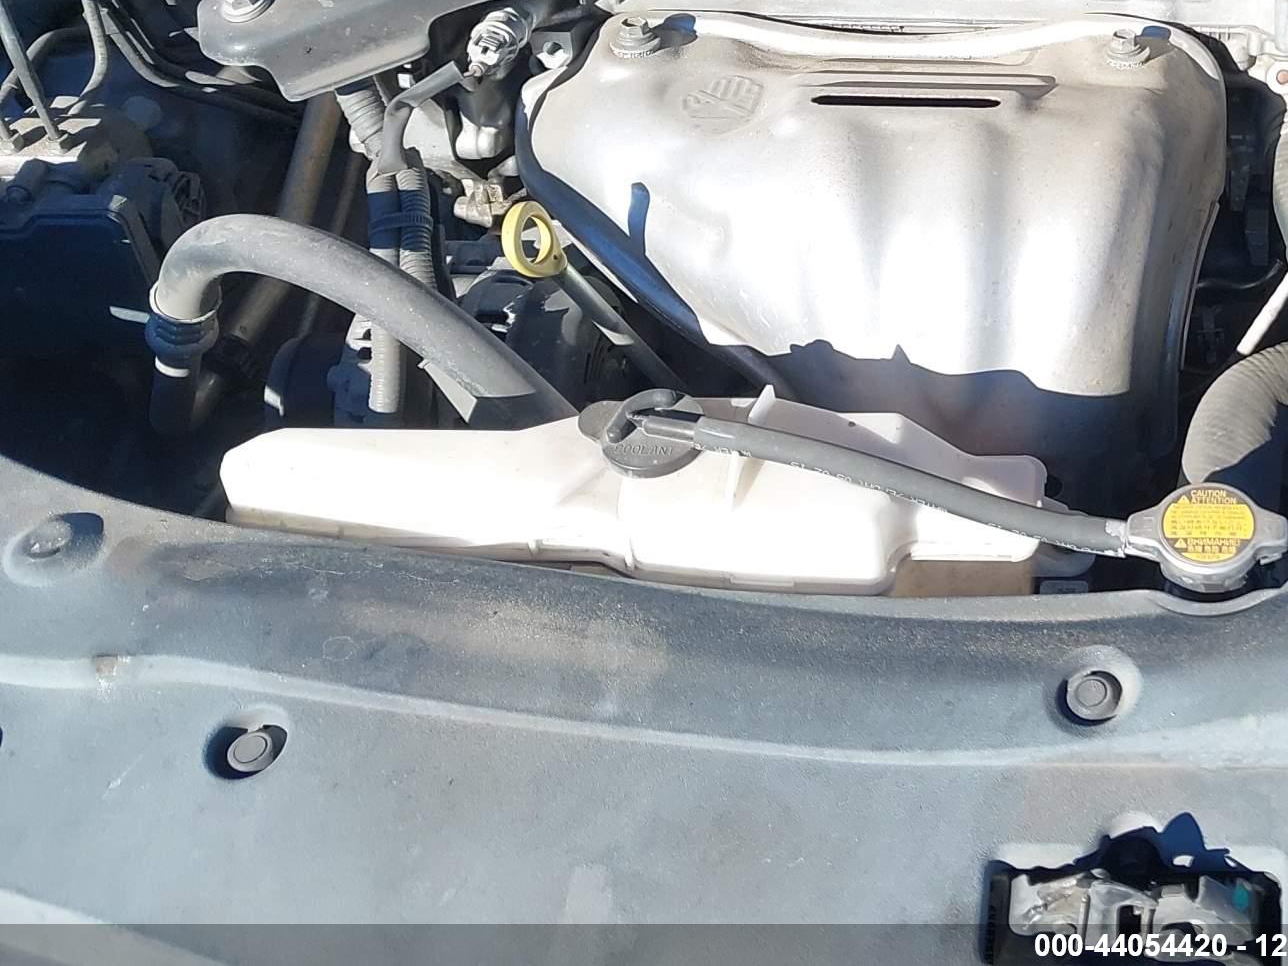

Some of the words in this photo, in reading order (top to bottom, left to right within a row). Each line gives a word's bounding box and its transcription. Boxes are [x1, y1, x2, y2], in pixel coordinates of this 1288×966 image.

[614, 443, 673, 457] COOLANT
[1190, 489, 1227, 497] CAUTION
[1191, 496, 1237, 504] ATTENTION
